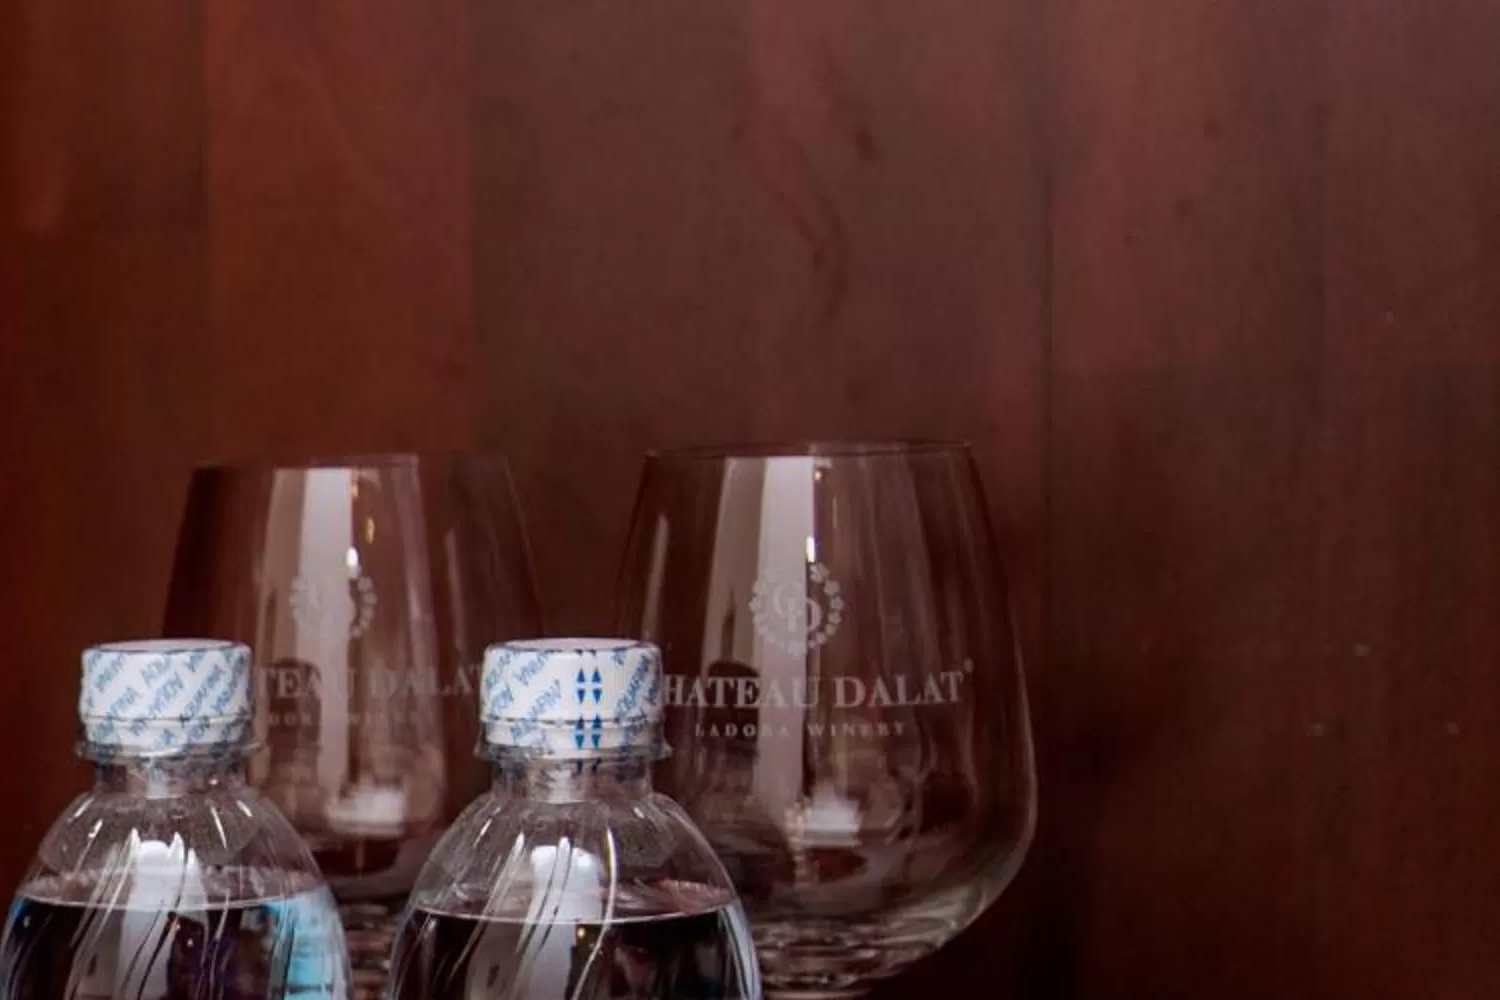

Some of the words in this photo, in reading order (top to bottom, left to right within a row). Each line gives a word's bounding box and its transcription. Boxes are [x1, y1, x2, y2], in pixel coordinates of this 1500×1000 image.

[663, 673, 821, 708] HATEAU
[834, 670, 965, 707] DALAT
[807, 721, 905, 738] WINERY
